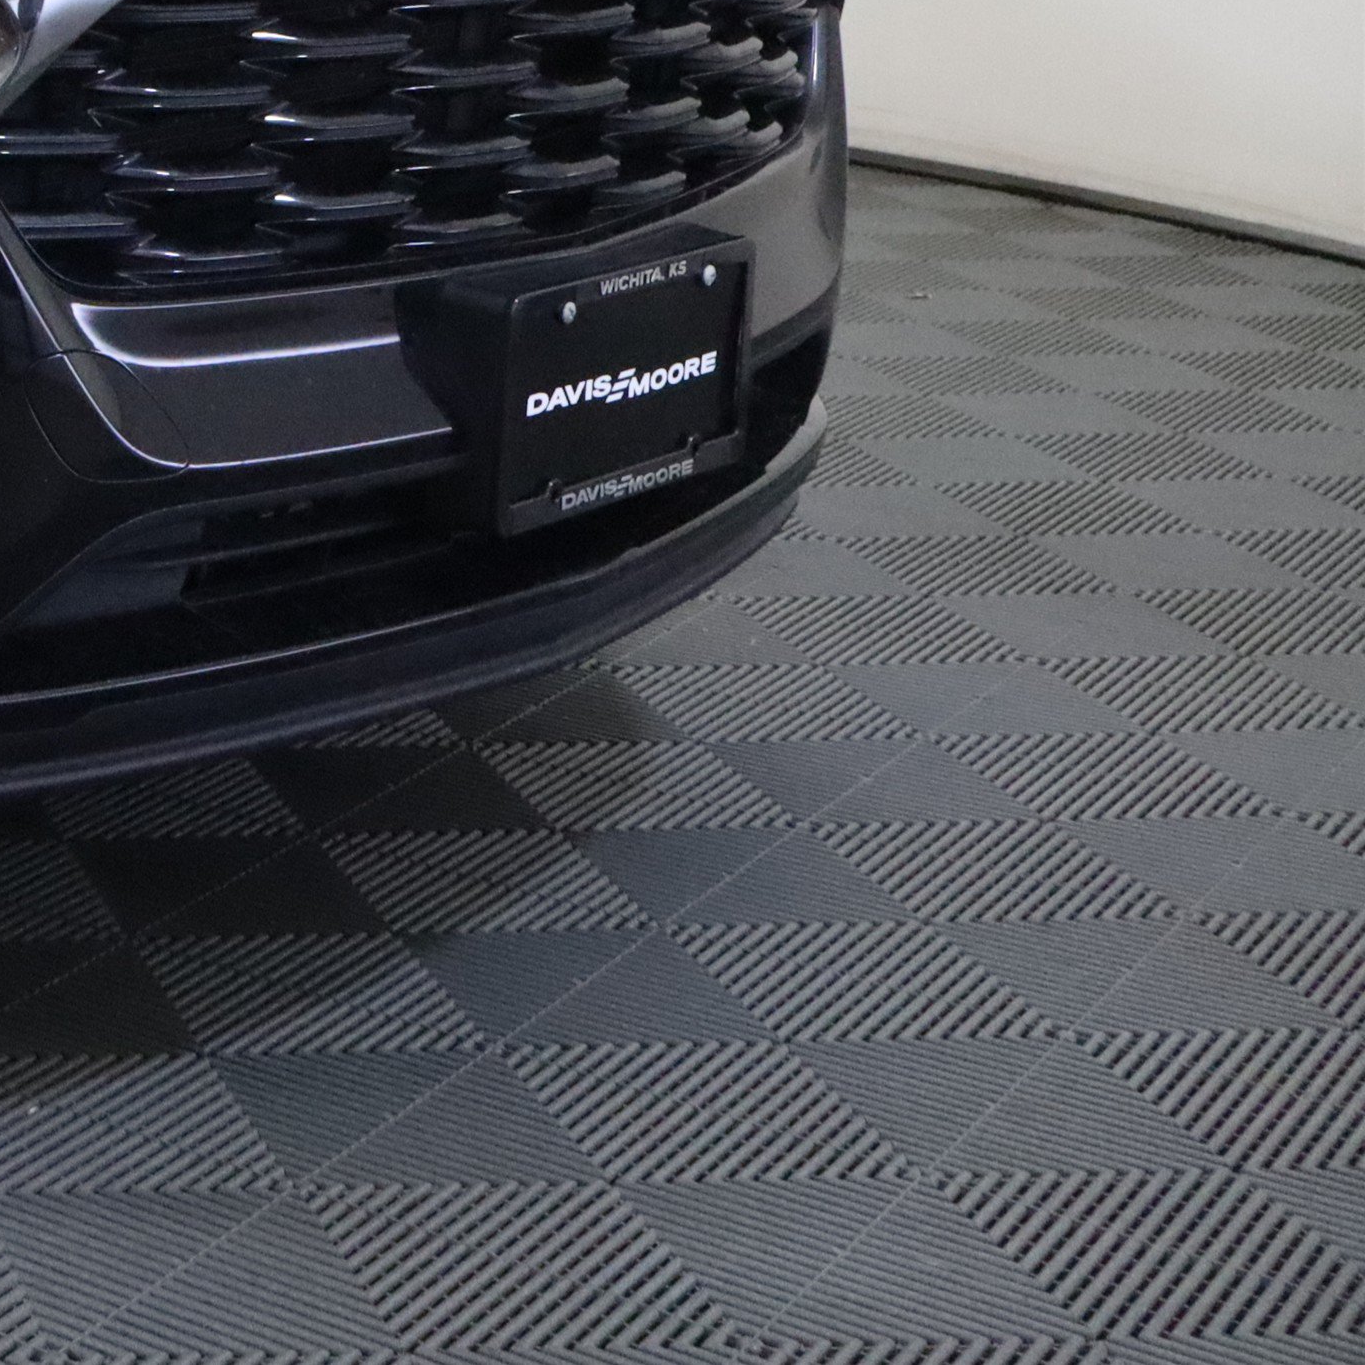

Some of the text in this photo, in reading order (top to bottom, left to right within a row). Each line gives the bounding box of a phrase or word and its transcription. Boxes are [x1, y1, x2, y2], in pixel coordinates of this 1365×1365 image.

[600, 261, 687, 295] WICHITA, KS
[526, 351, 717, 417] DAVIS MOORE
[561, 459, 694, 510] DAVIS MOORE
